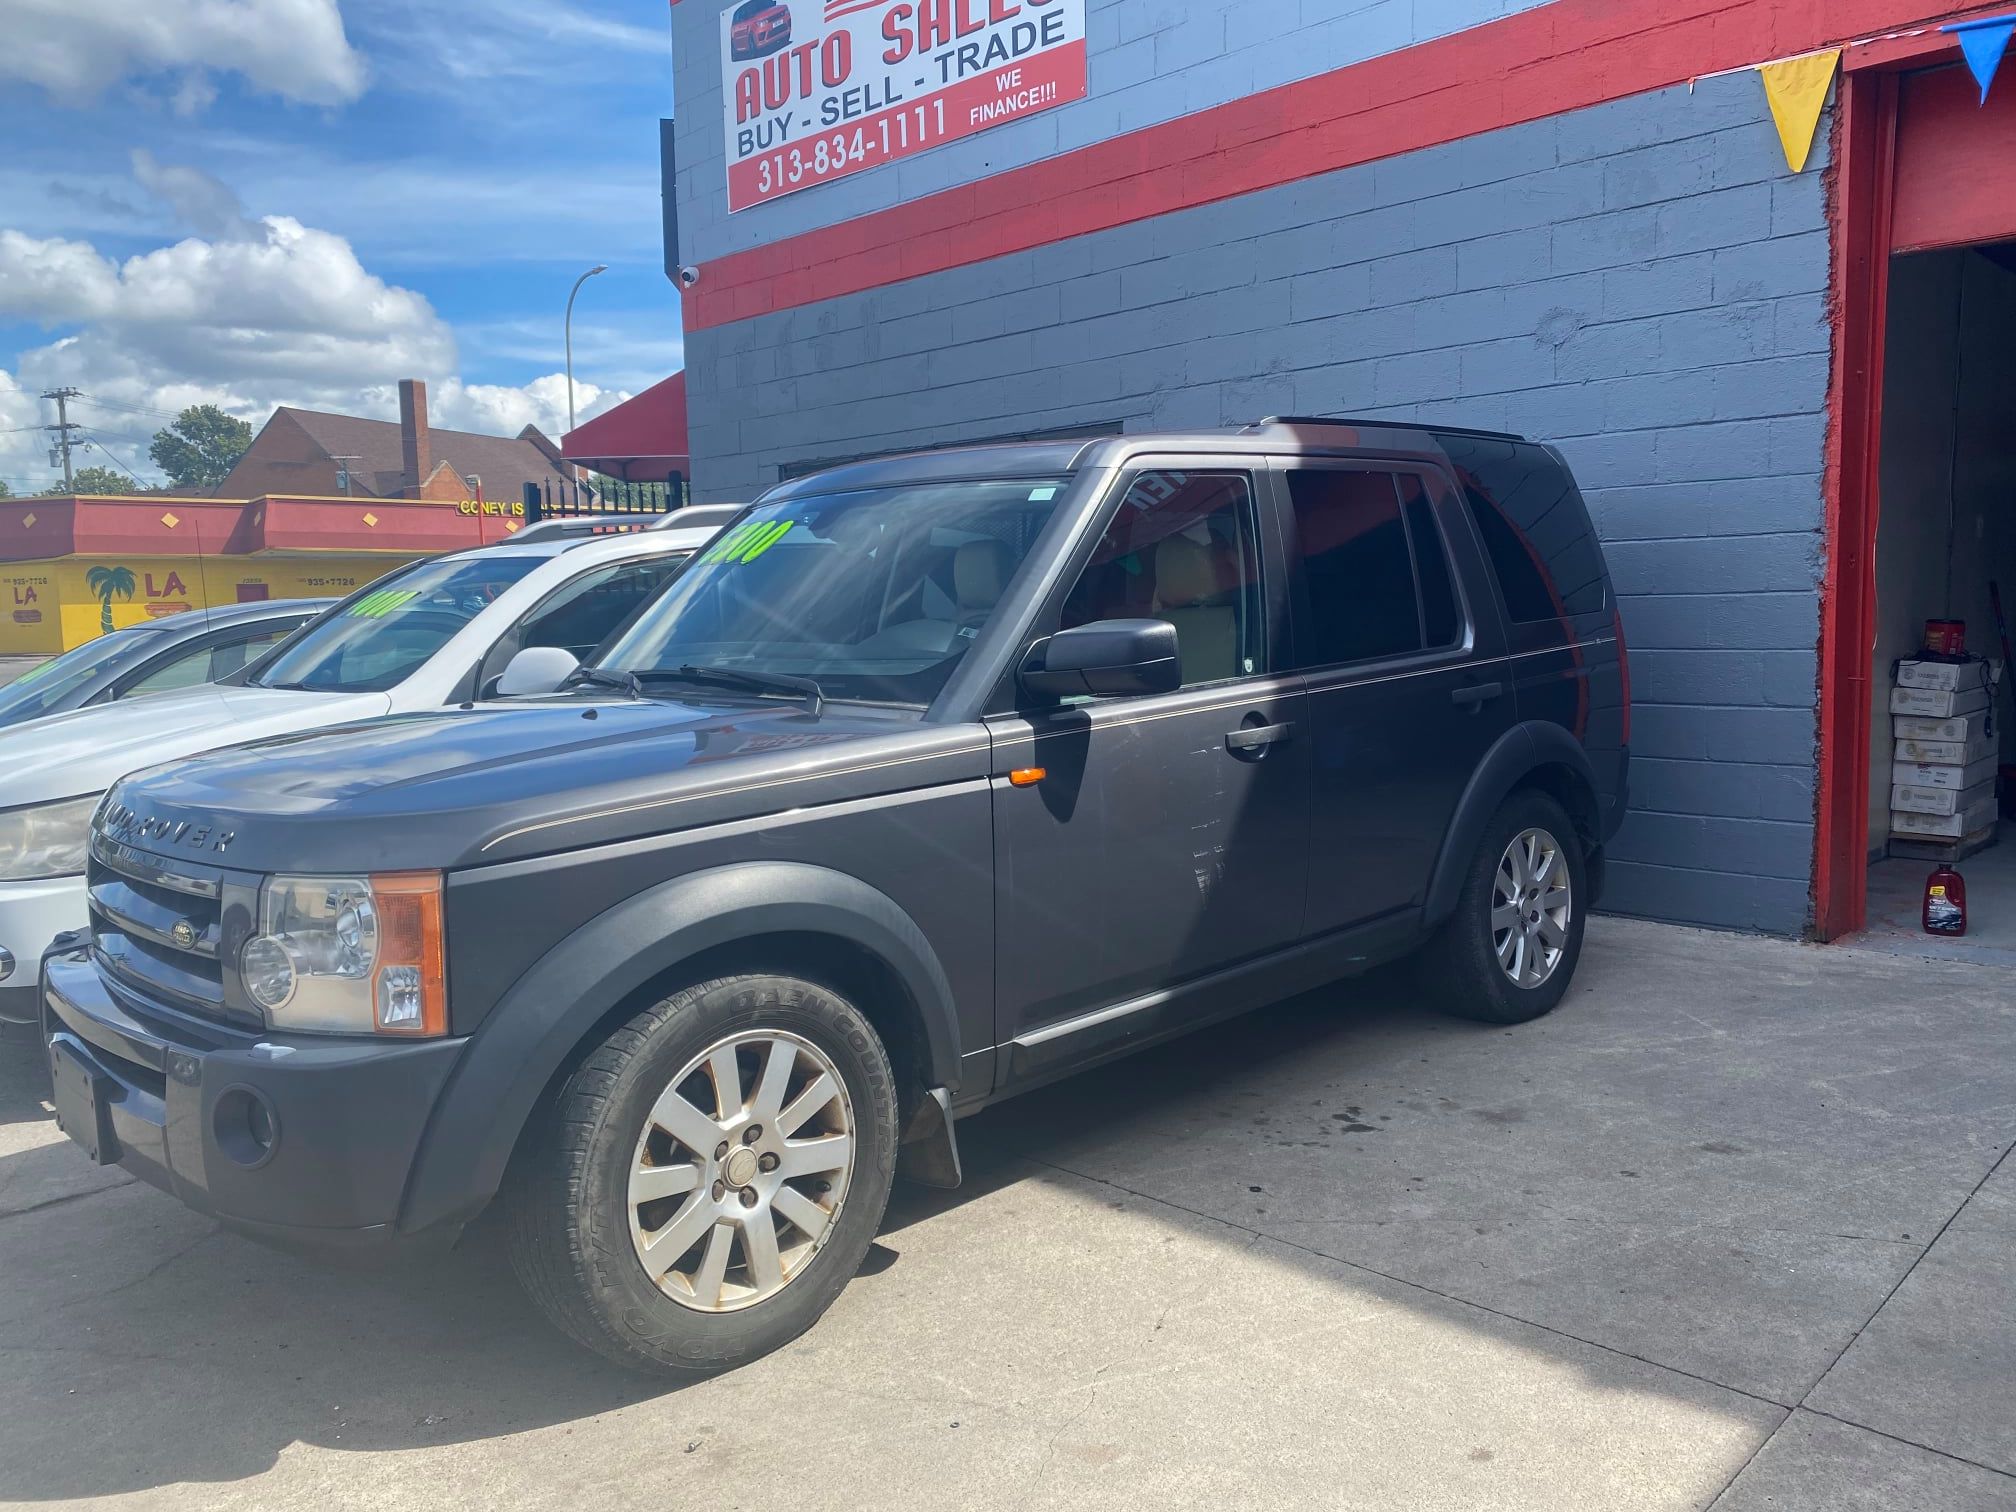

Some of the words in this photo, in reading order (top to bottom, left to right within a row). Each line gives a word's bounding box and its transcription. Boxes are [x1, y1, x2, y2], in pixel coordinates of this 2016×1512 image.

[736, 29, 852, 125] AUTO
[738, 112, 793, 158] BUY
[820, 76, 903, 126] SELL
[934, 9, 1065, 84] TRADE
[996, 68, 1021, 92] WE
[970, 81, 1056, 126] FINANCE!!!
[758, 98, 944, 193] 313-834-1111
[460, 500, 506, 515] CONEY
[14, 585, 37, 606] LA
[144, 571, 187, 598] LA
[139, 816, 235, 852] ROVER
[729, 988, 828, 1016] OPEN
[832, 1013, 893, 1177] COUNTRY
